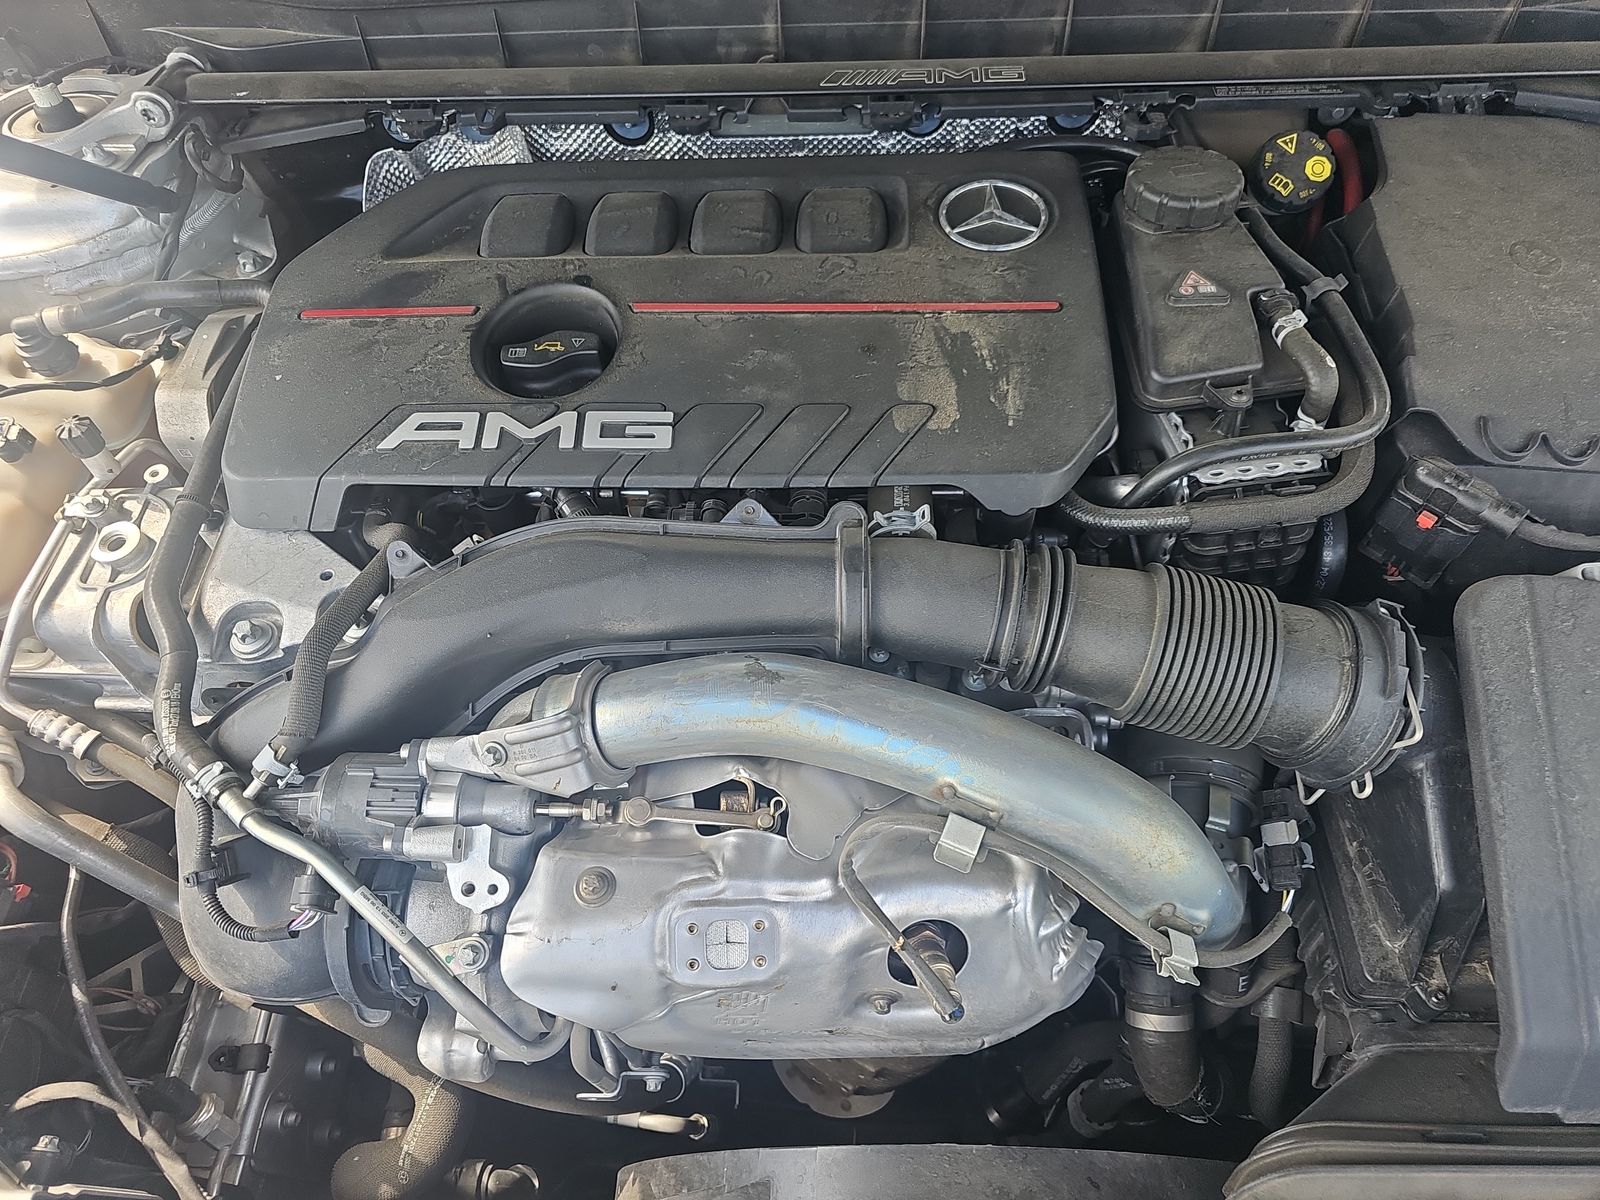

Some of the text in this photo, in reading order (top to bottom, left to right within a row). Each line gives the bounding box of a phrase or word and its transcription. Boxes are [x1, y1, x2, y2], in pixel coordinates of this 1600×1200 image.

[887, 65, 1026, 84] AMG
[376, 411, 674, 450] AMG
[1238, 975, 1249, 992] E
